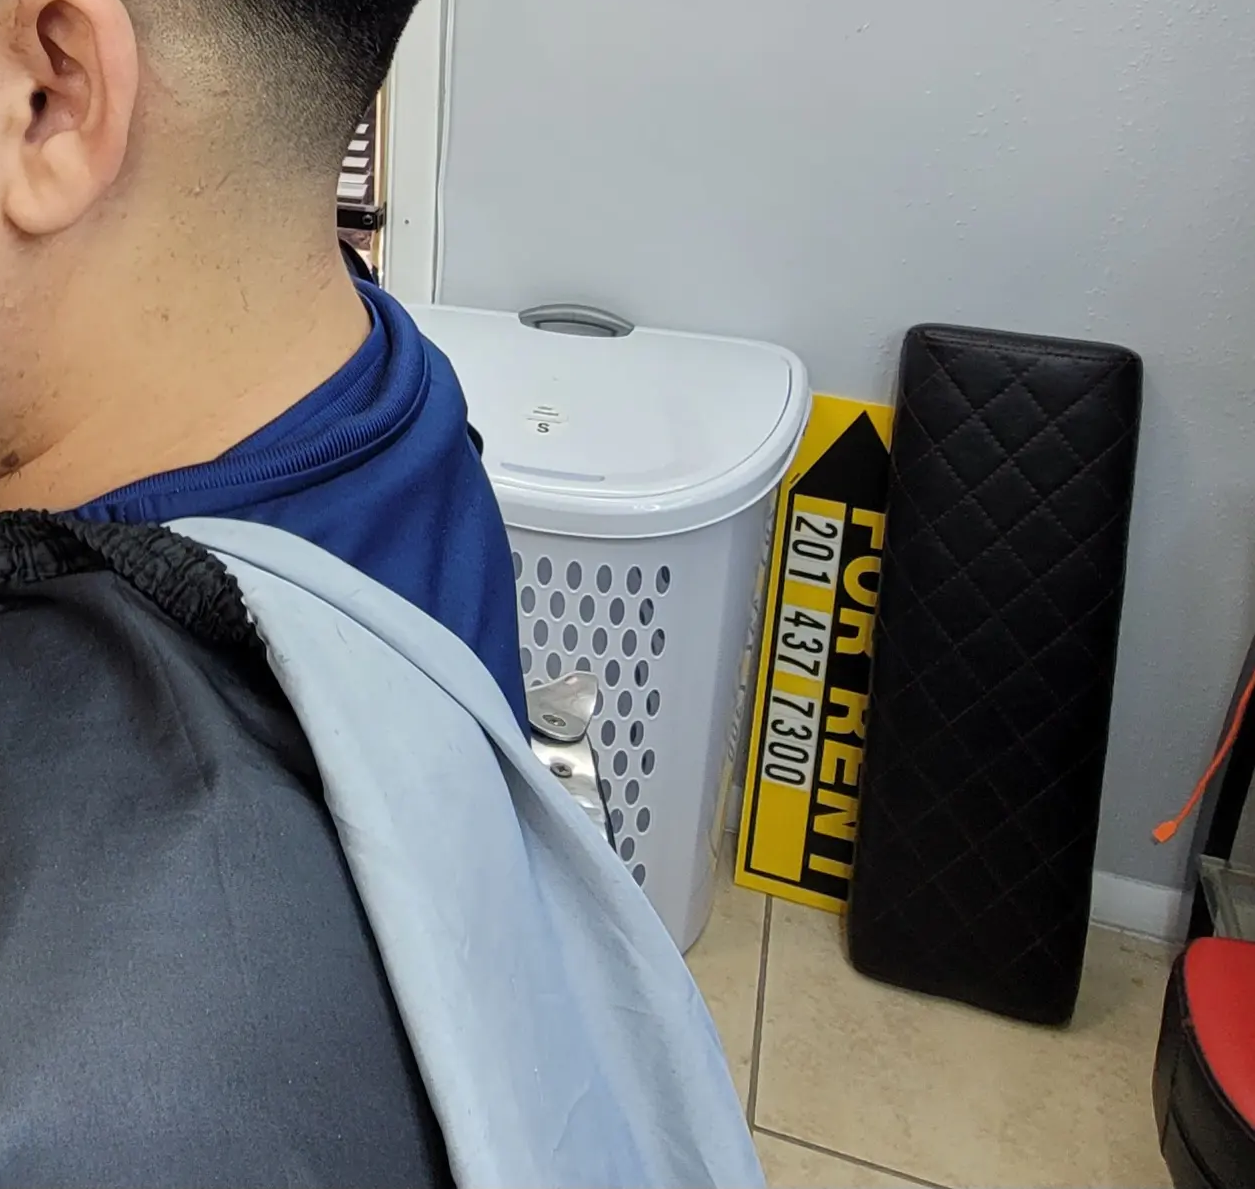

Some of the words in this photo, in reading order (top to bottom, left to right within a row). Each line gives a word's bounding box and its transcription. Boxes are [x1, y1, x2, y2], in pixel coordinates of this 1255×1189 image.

[788, 515, 839, 585] 201
[835, 506, 887, 658] FOR
[777, 610, 827, 677] 437
[764, 695, 815, 787] 7300
